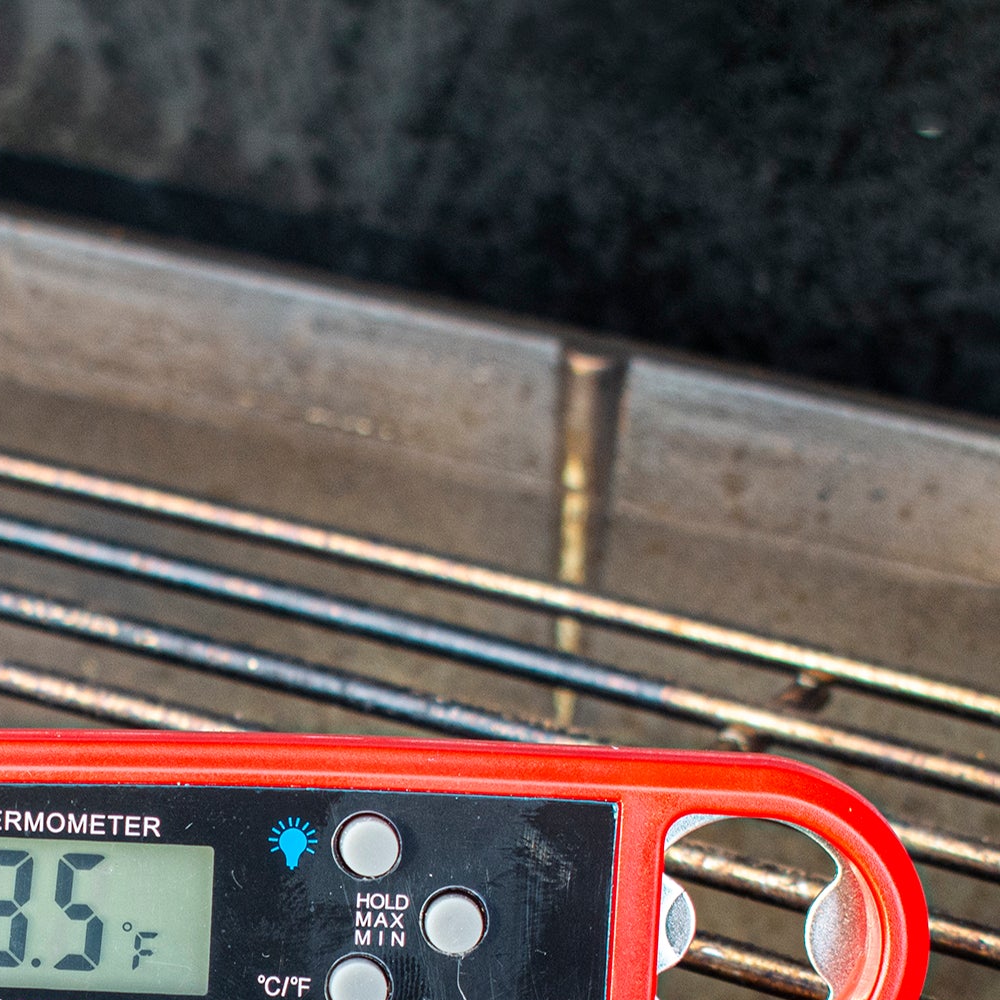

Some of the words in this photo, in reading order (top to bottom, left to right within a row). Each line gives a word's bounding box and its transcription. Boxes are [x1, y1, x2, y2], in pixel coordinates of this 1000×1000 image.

[356, 892, 409, 911] HOLD
[355, 912, 404, 928] MAX
[354, 929, 405, 947] MIN
